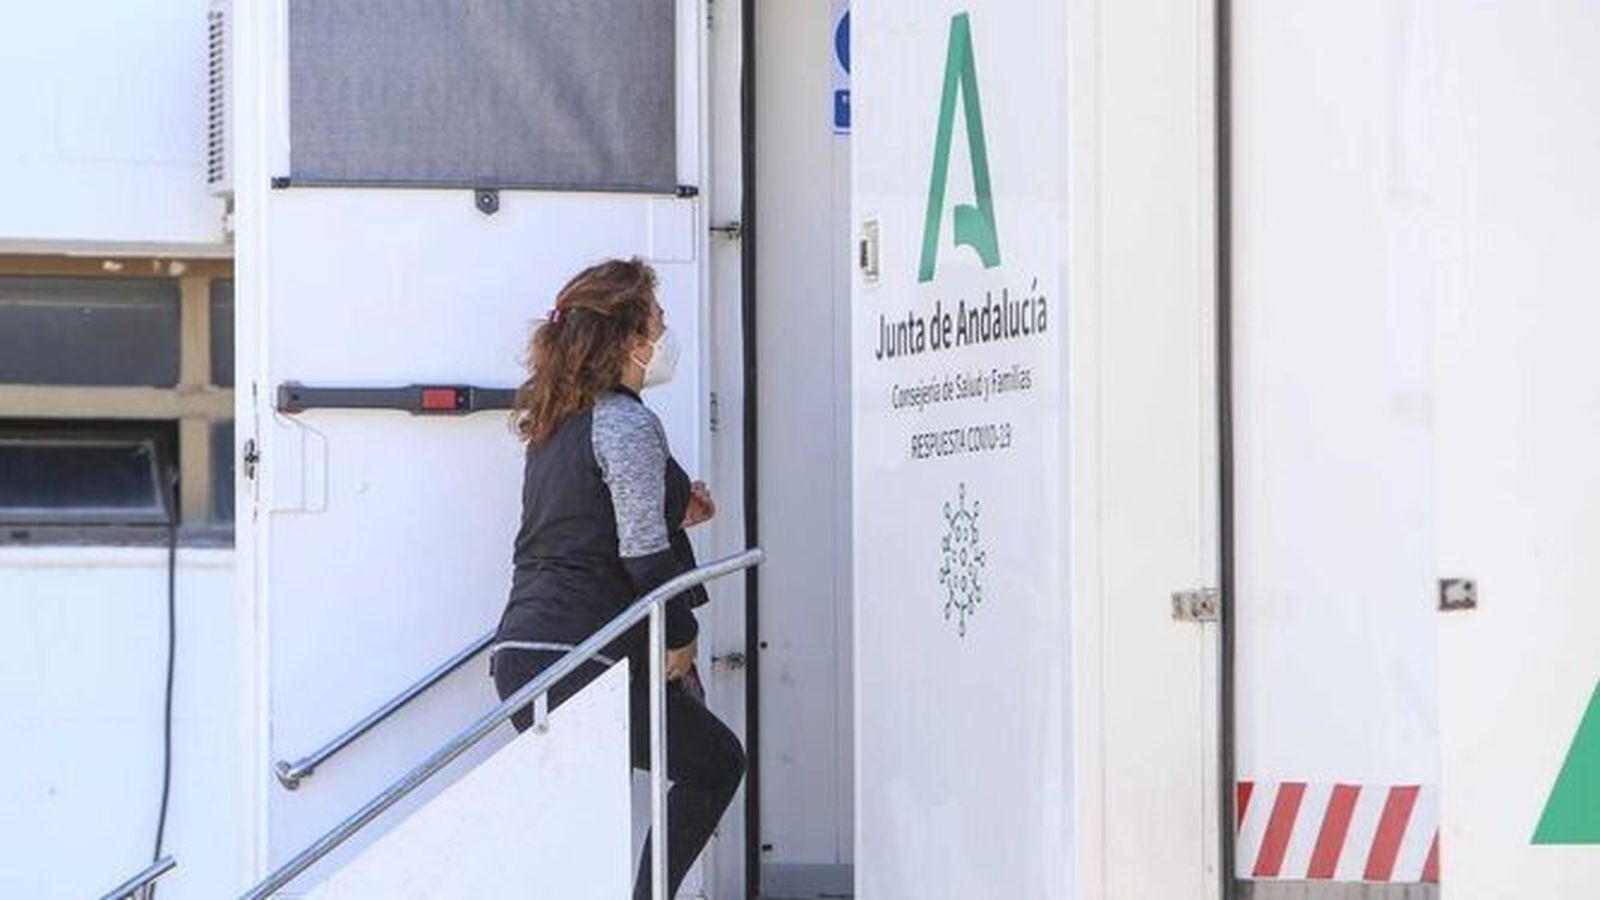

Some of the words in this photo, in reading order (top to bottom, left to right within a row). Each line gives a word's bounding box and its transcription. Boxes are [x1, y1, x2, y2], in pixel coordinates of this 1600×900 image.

[875, 311, 925, 361] Junta
[930, 300, 952, 351] de
[956, 277, 1048, 346] Andalucía
[942, 374, 954, 402] de
[956, 370, 983, 400] Salud
[983, 377, 990, 402] y
[992, 364, 1033, 394] Familias
[911, 428, 966, 459] RESPUESTA
[967, 422, 1012, 452] COVID-19
